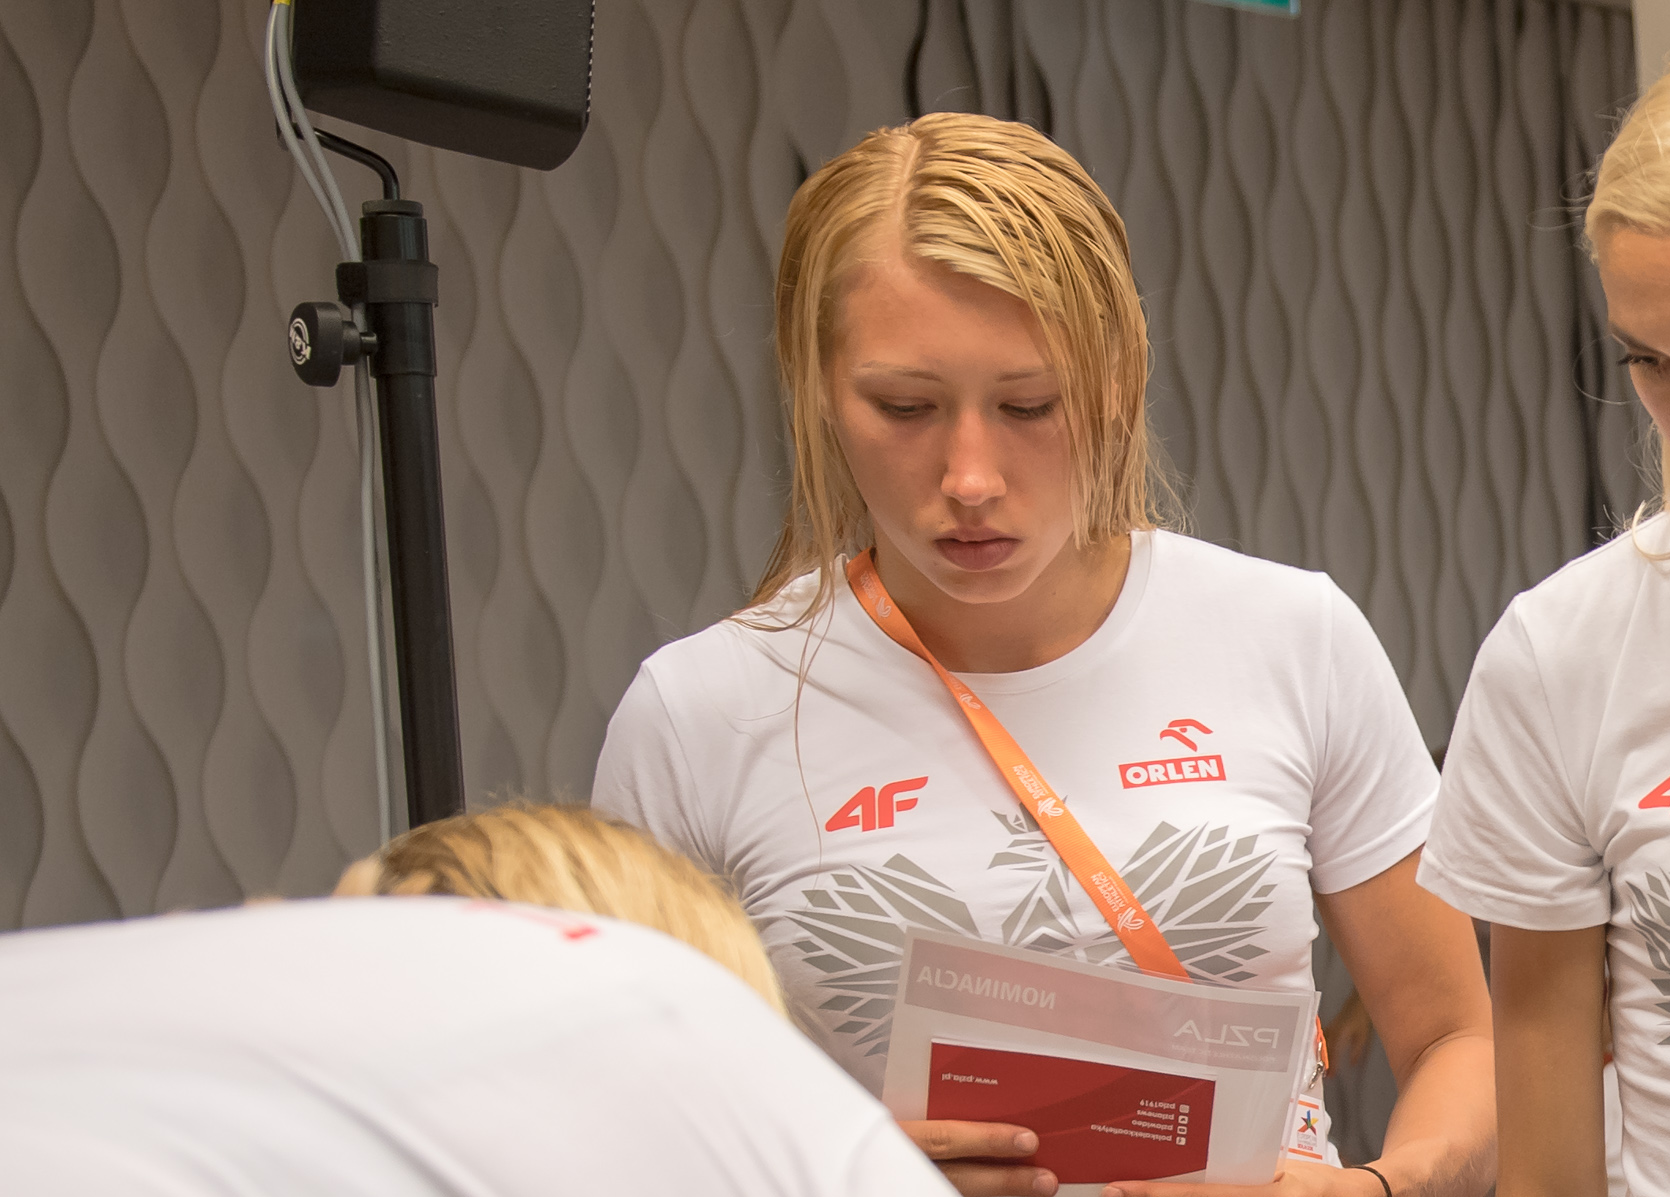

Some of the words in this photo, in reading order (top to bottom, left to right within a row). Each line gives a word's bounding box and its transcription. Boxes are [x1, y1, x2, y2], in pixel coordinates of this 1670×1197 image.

[1125, 758, 1220, 784] ORLEN
[825, 777, 929, 832] 4F
[1090, 874, 1120, 912] EUROPEAN
[1098, 872, 1126, 908] ATHLETICS
[941, 1072, 998, 1085] www.pzla.pl
[1139, 1099, 1176, 1110] pzla1919
[1136, 1109, 1175, 1120] pzlanews
[1131, 1120, 1174, 1131] pzlawideo
